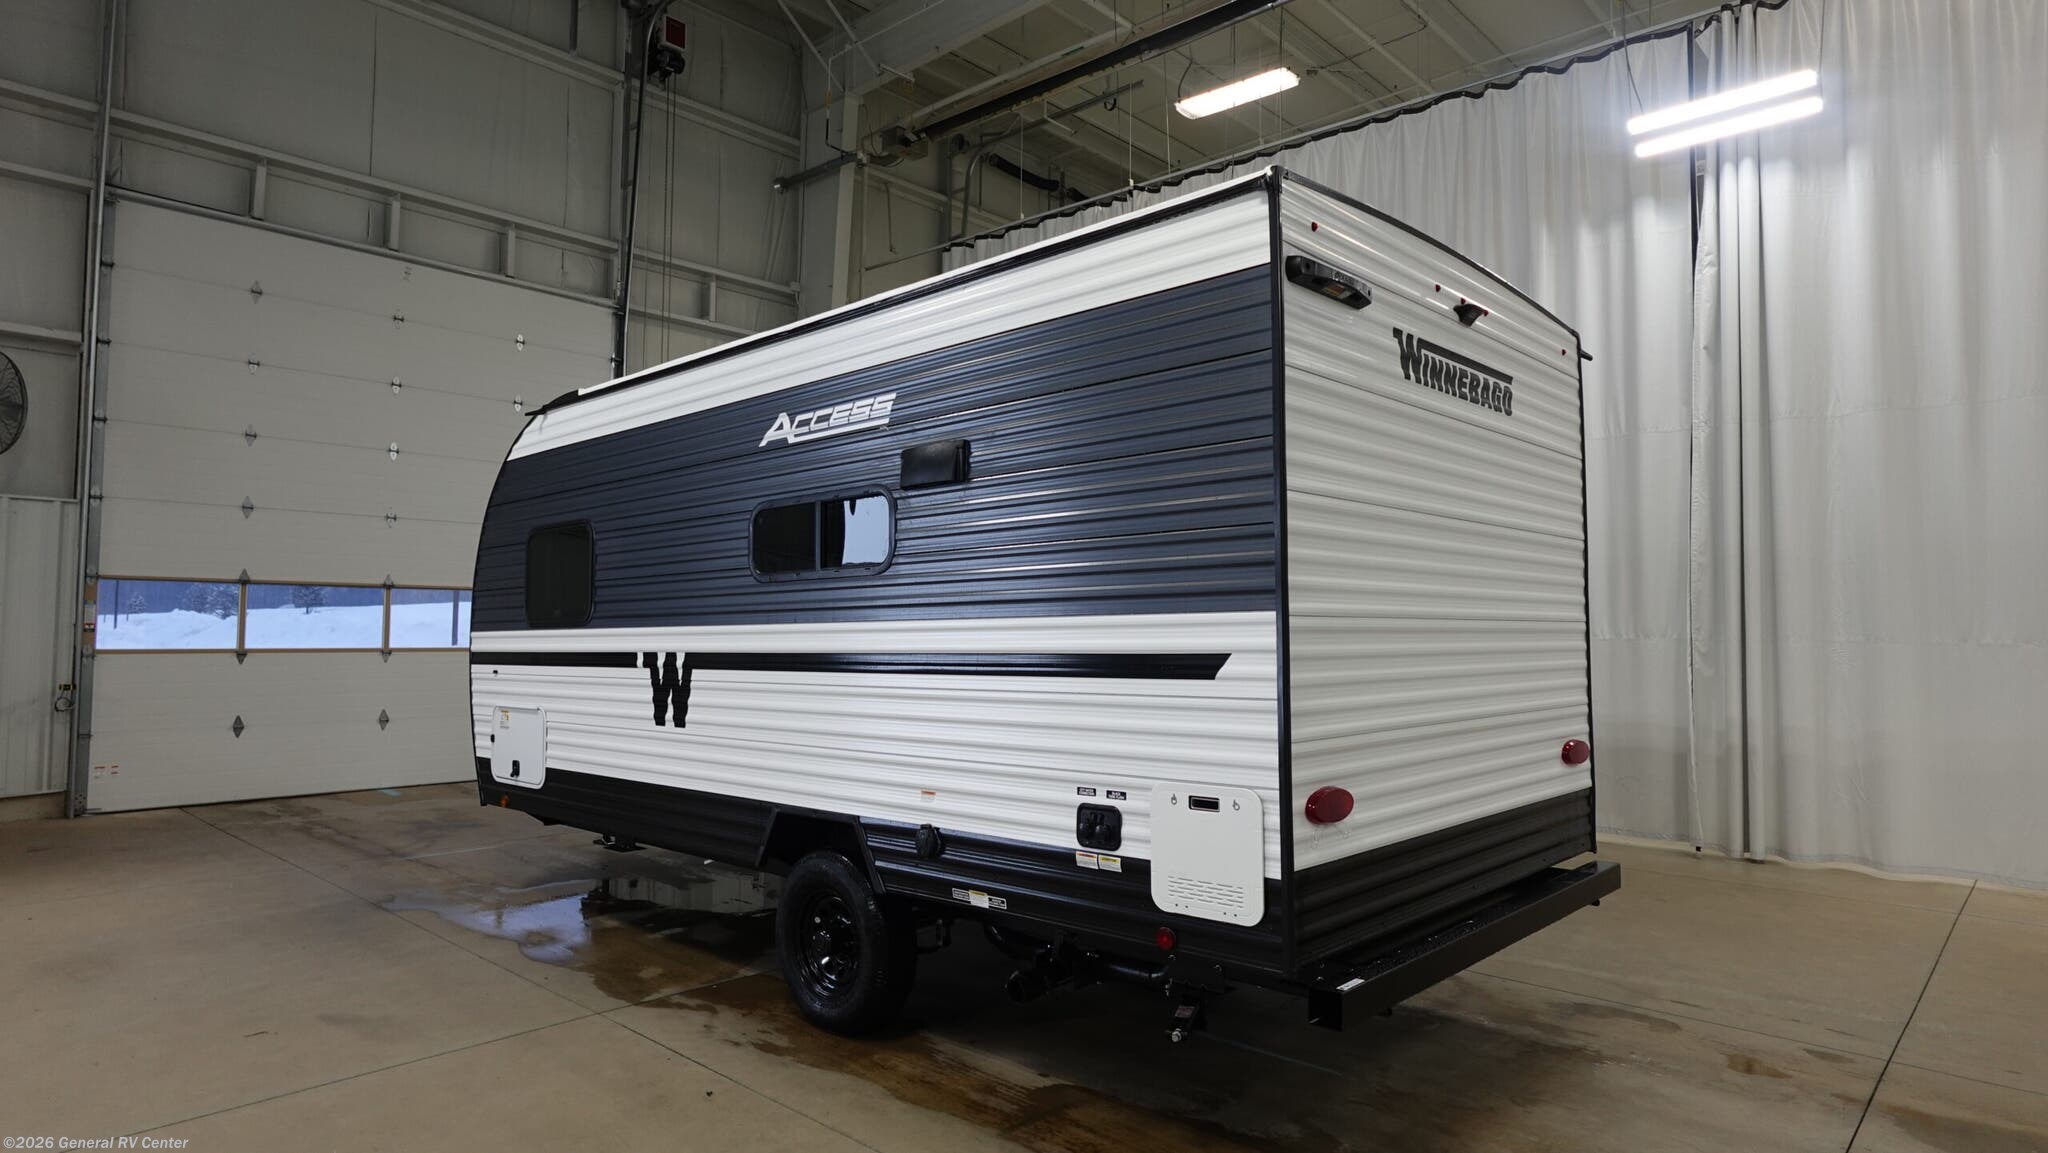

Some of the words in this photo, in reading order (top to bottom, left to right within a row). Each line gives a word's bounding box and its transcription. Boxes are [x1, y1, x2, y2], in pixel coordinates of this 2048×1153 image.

[1393, 326, 1513, 416] WINNEBAGO
[759, 392, 897, 447] ACCESS
[642, 652, 692, 728] W
